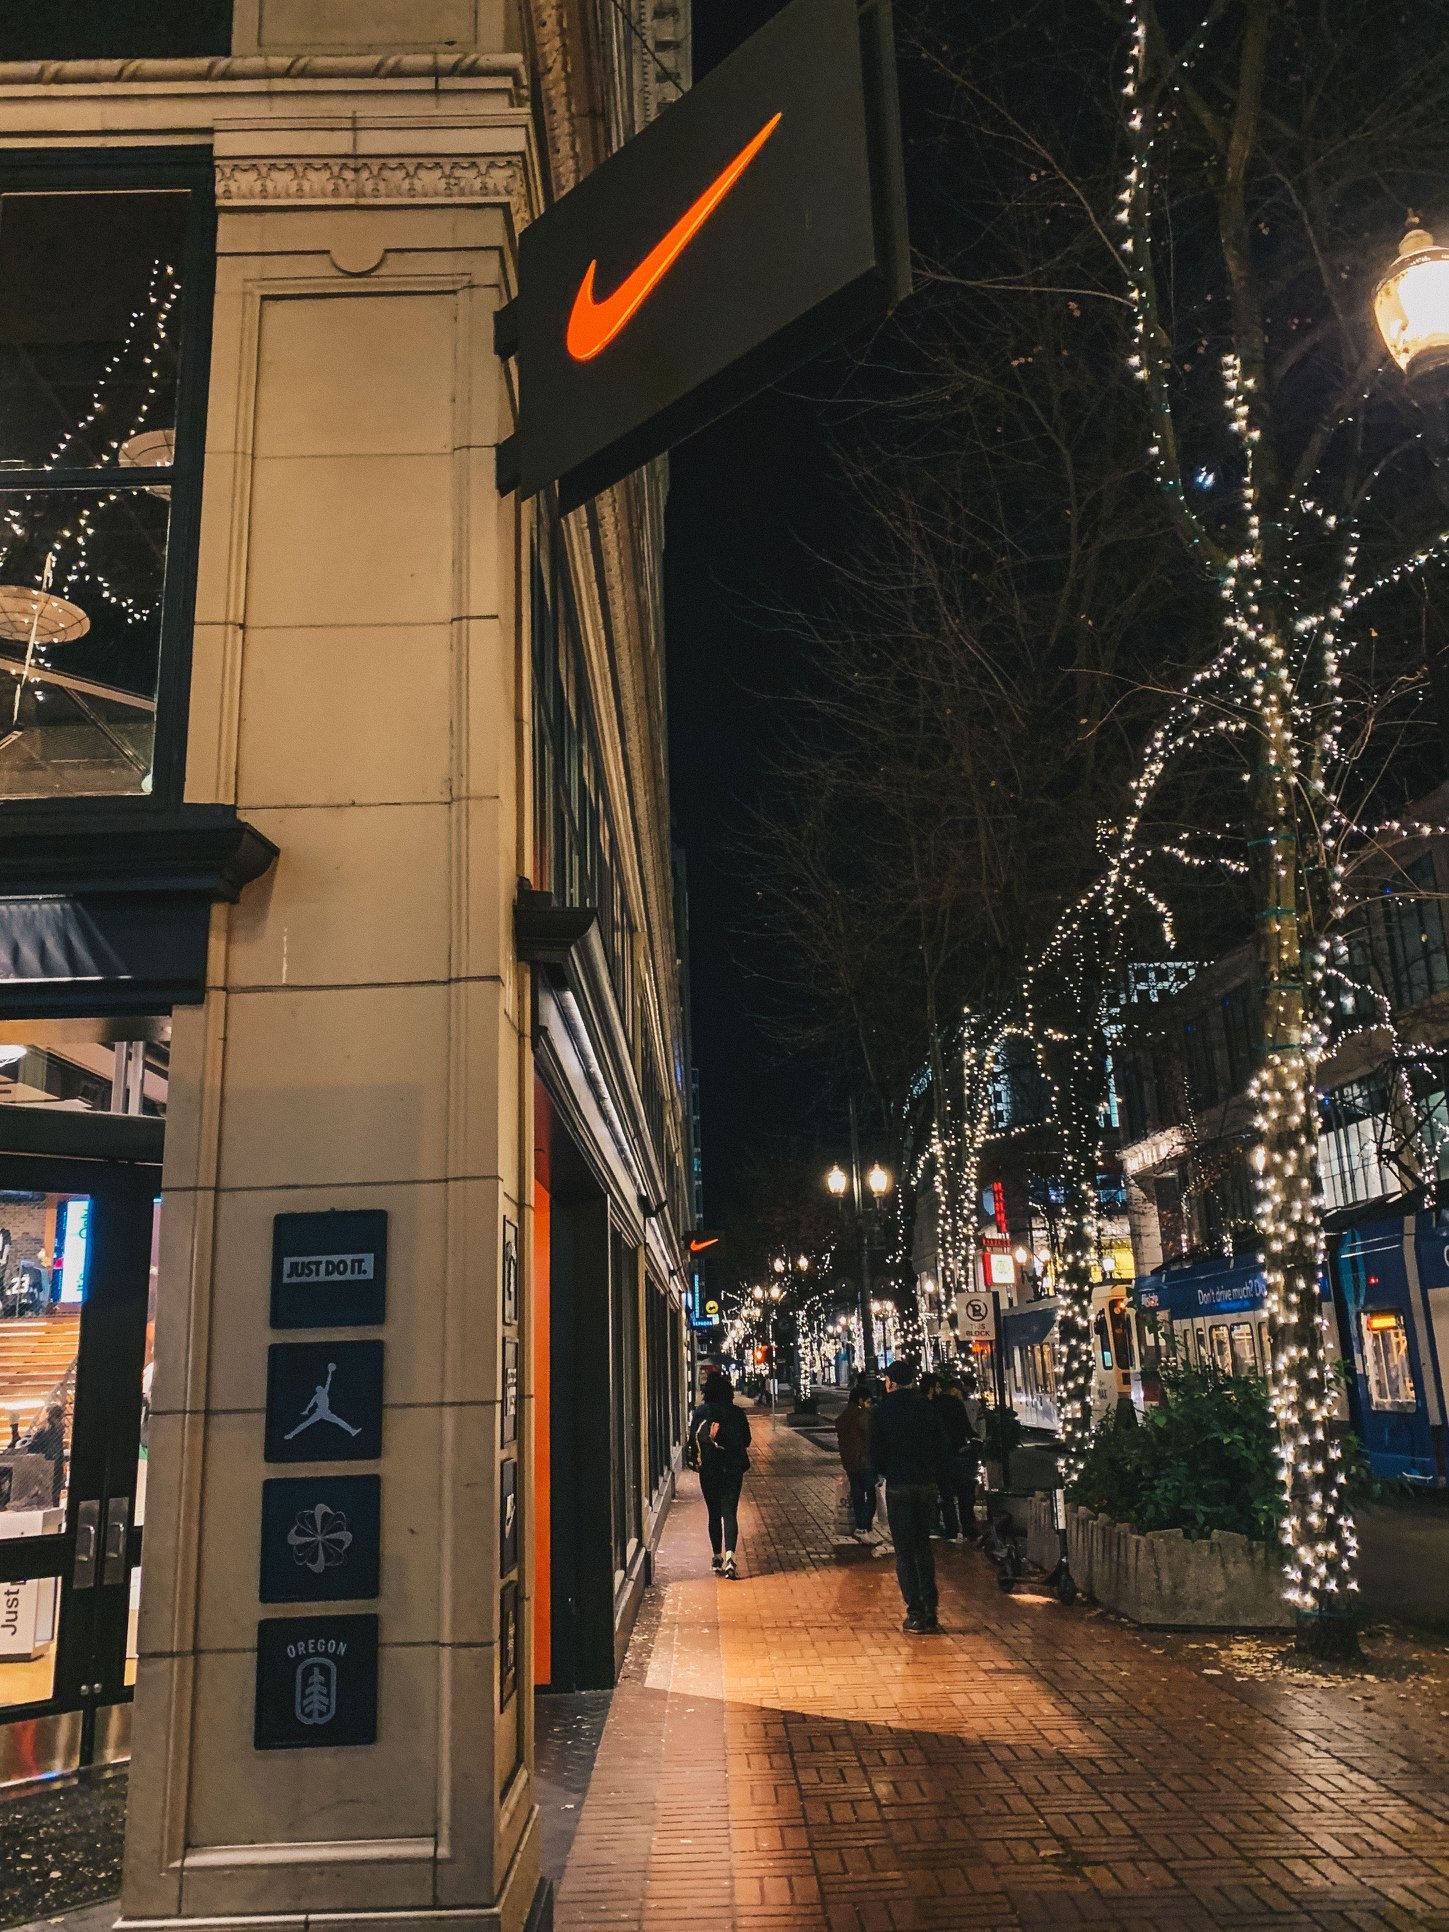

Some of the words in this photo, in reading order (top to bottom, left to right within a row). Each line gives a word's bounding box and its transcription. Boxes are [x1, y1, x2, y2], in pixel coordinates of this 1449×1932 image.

[286, 1260, 323, 1278] JUST
[324, 1259, 348, 1277] DO
[350, 1258, 368, 1275] IT.
[1197, 1289, 1216, 1305] Don't
[1216, 1285, 1232, 1302] drive
[1232, 1280, 1253, 1299] much?
[0, 1588, 20, 1636] Just
[286, 1639, 347, 1658] OREGON
